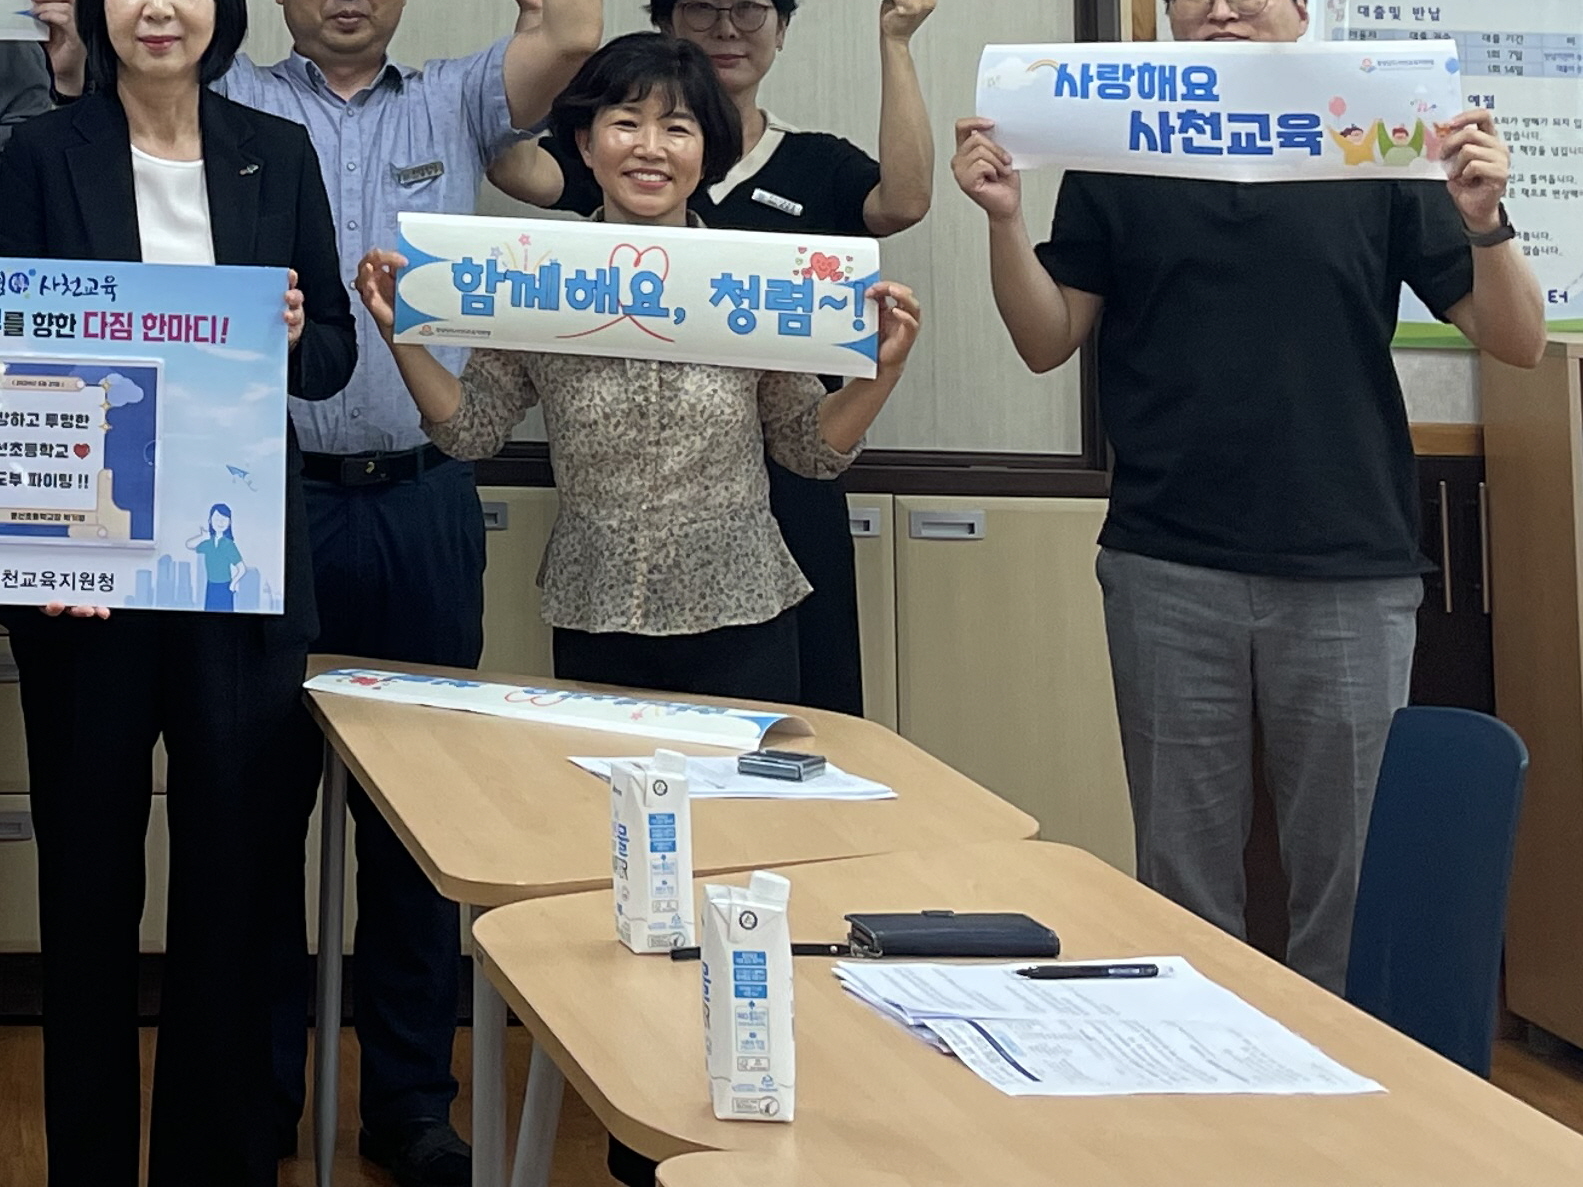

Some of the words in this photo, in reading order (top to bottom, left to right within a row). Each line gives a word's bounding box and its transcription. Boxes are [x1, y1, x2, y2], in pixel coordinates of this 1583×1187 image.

[1054, 62, 1220, 102] 사랑해요
[1128, 109, 1323, 157] 사천교육
[451, 256, 686, 325] 함께해요,
[709, 272, 868, 337] 청렴~!
[32, 308, 77, 340] 향한
[83, 311, 134, 343] 다짐
[142, 312, 229, 345] 한마디!
